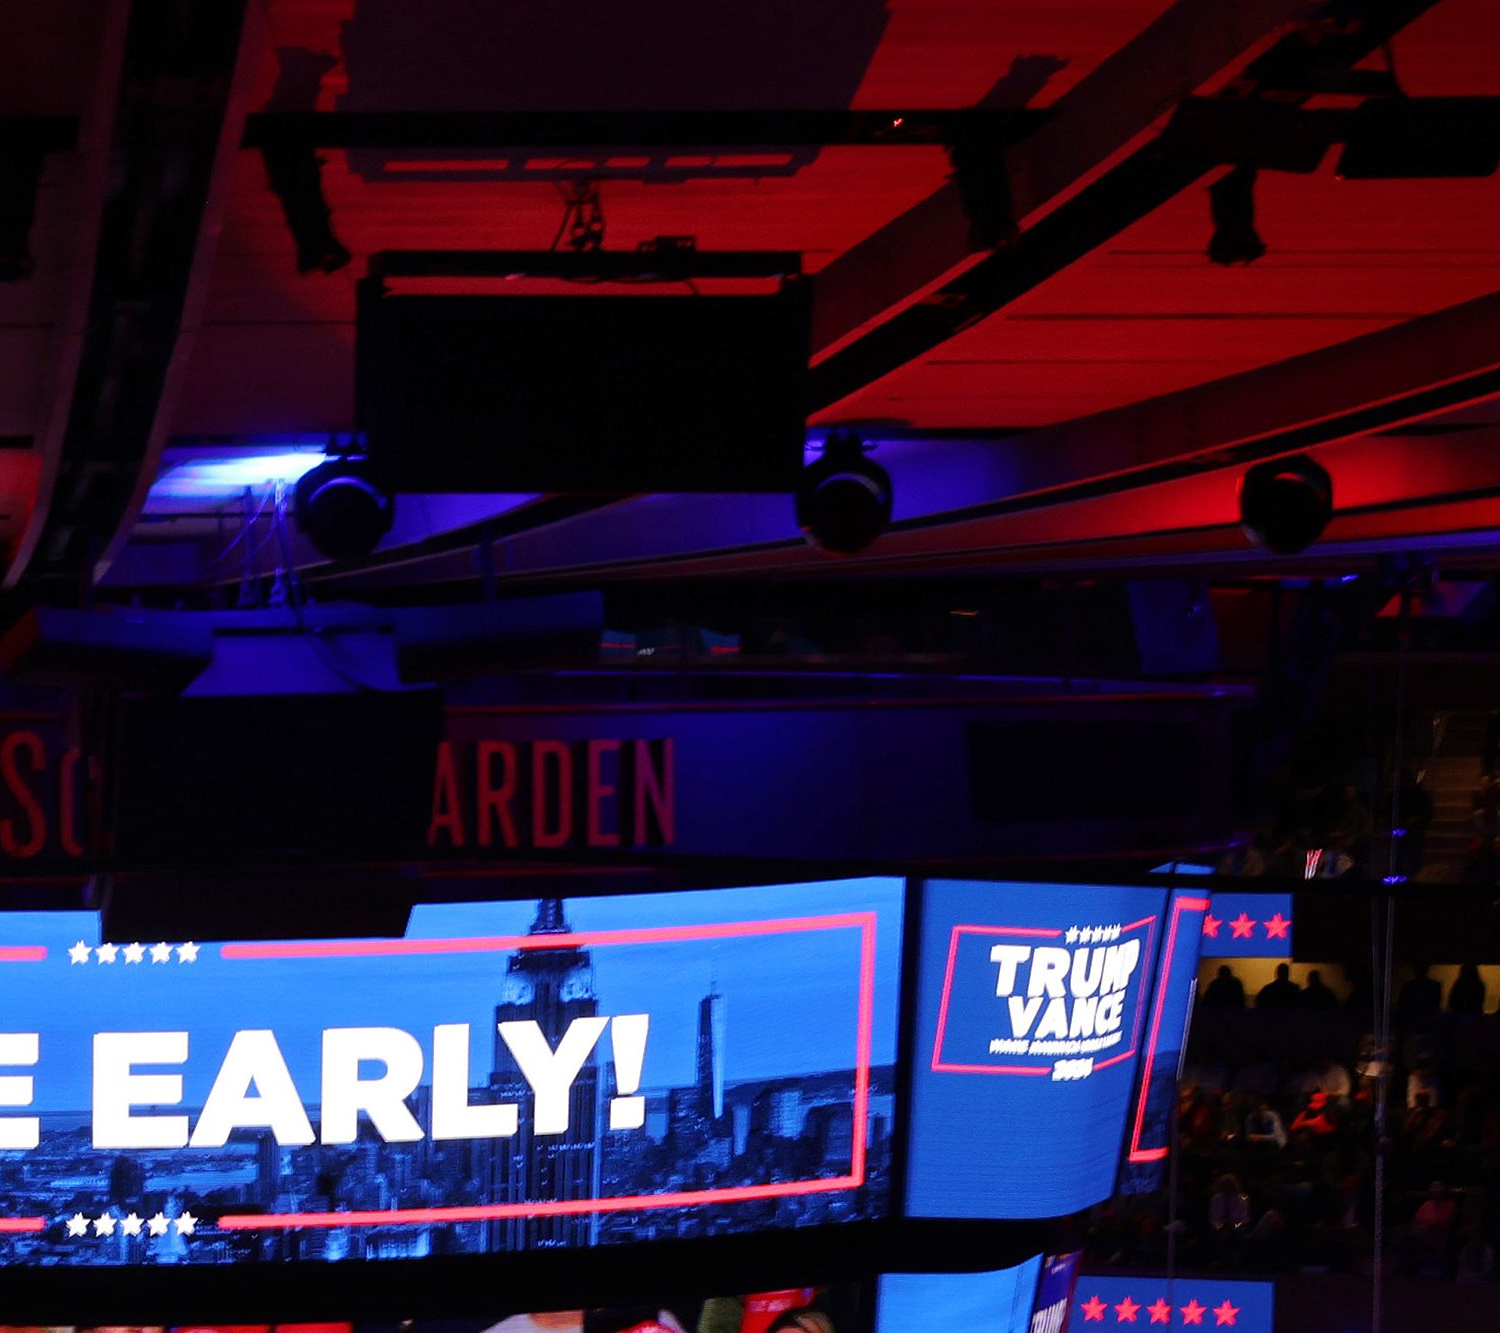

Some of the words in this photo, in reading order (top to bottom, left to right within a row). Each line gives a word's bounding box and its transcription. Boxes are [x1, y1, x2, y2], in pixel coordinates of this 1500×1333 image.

[990, 938, 1140, 998] TRUMP
[1008, 990, 1126, 1039] VANCE
[92, 1013, 650, 1150] EARLY!
